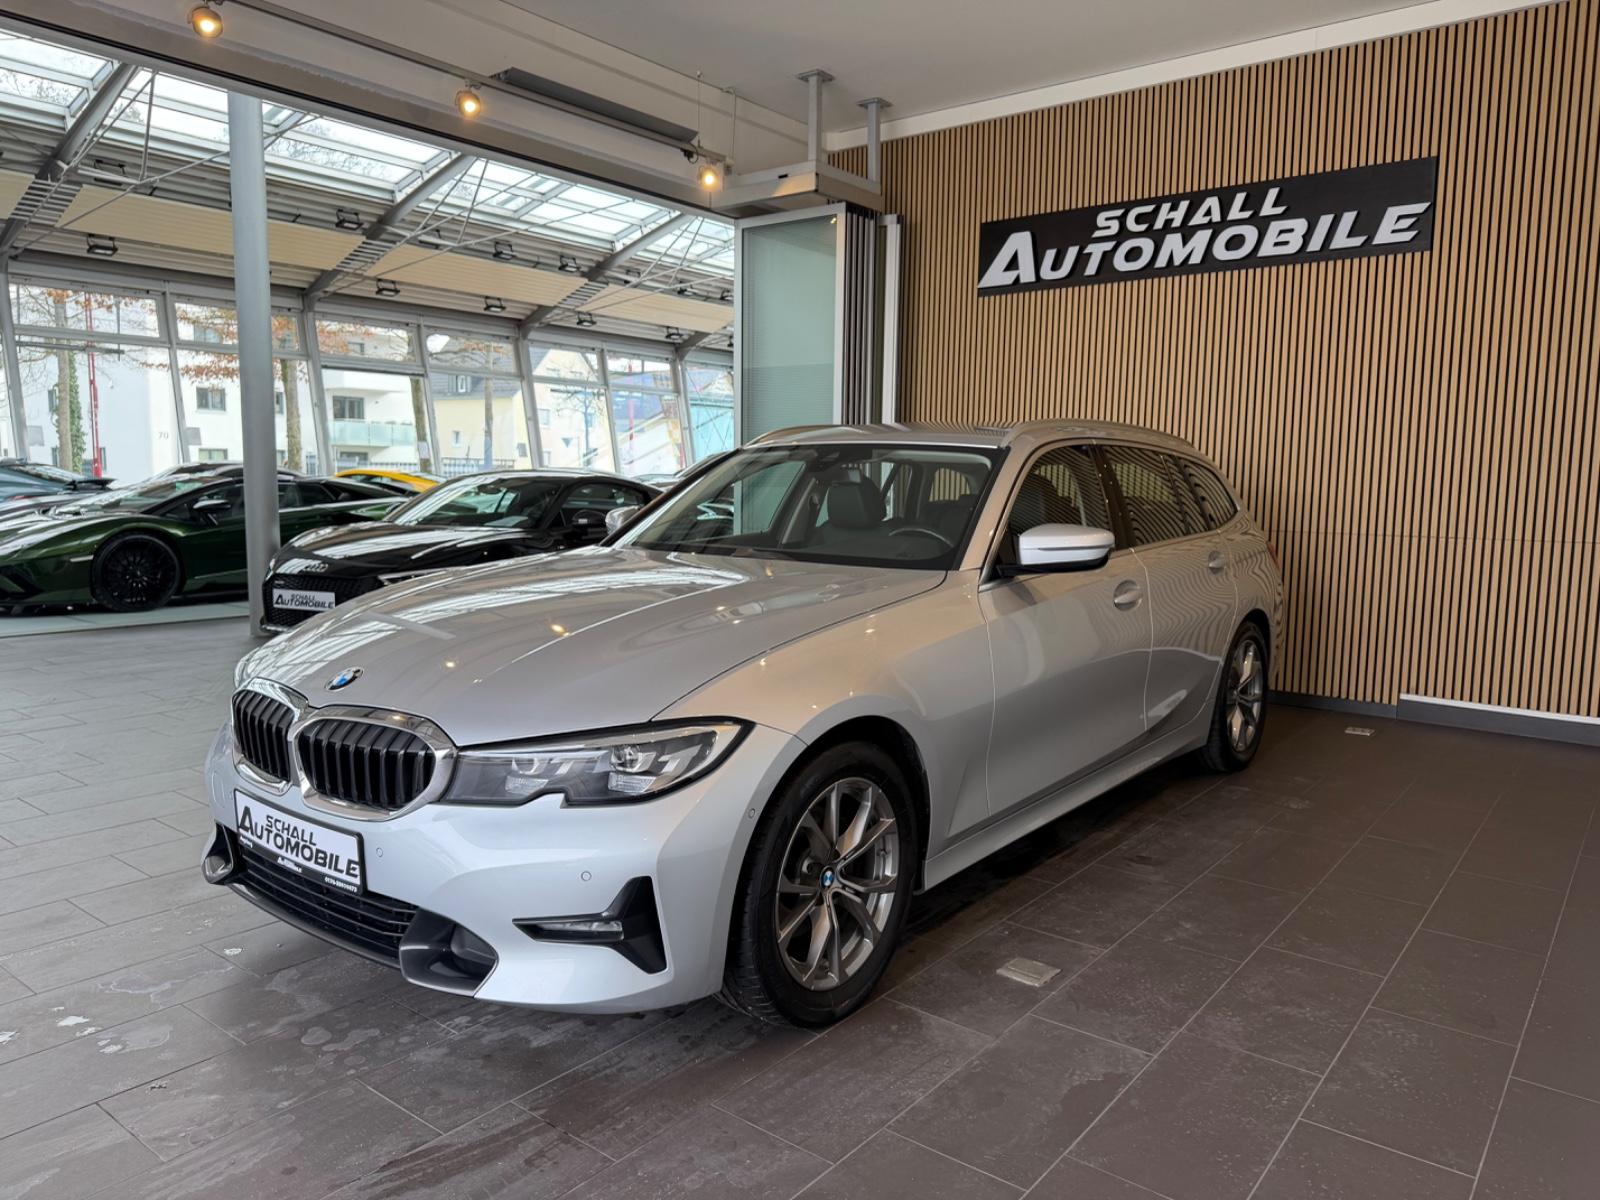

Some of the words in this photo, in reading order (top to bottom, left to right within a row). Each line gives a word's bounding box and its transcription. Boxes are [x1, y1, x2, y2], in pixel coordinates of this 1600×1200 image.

[1092, 187, 1290, 239] SCHALL
[978, 201, 1431, 290] AUTOMOBILE
[274, 594, 334, 609] AUTOMOBILE
[239, 805, 361, 879] AUTOMOBILE
[265, 814, 317, 847] SCHALL
